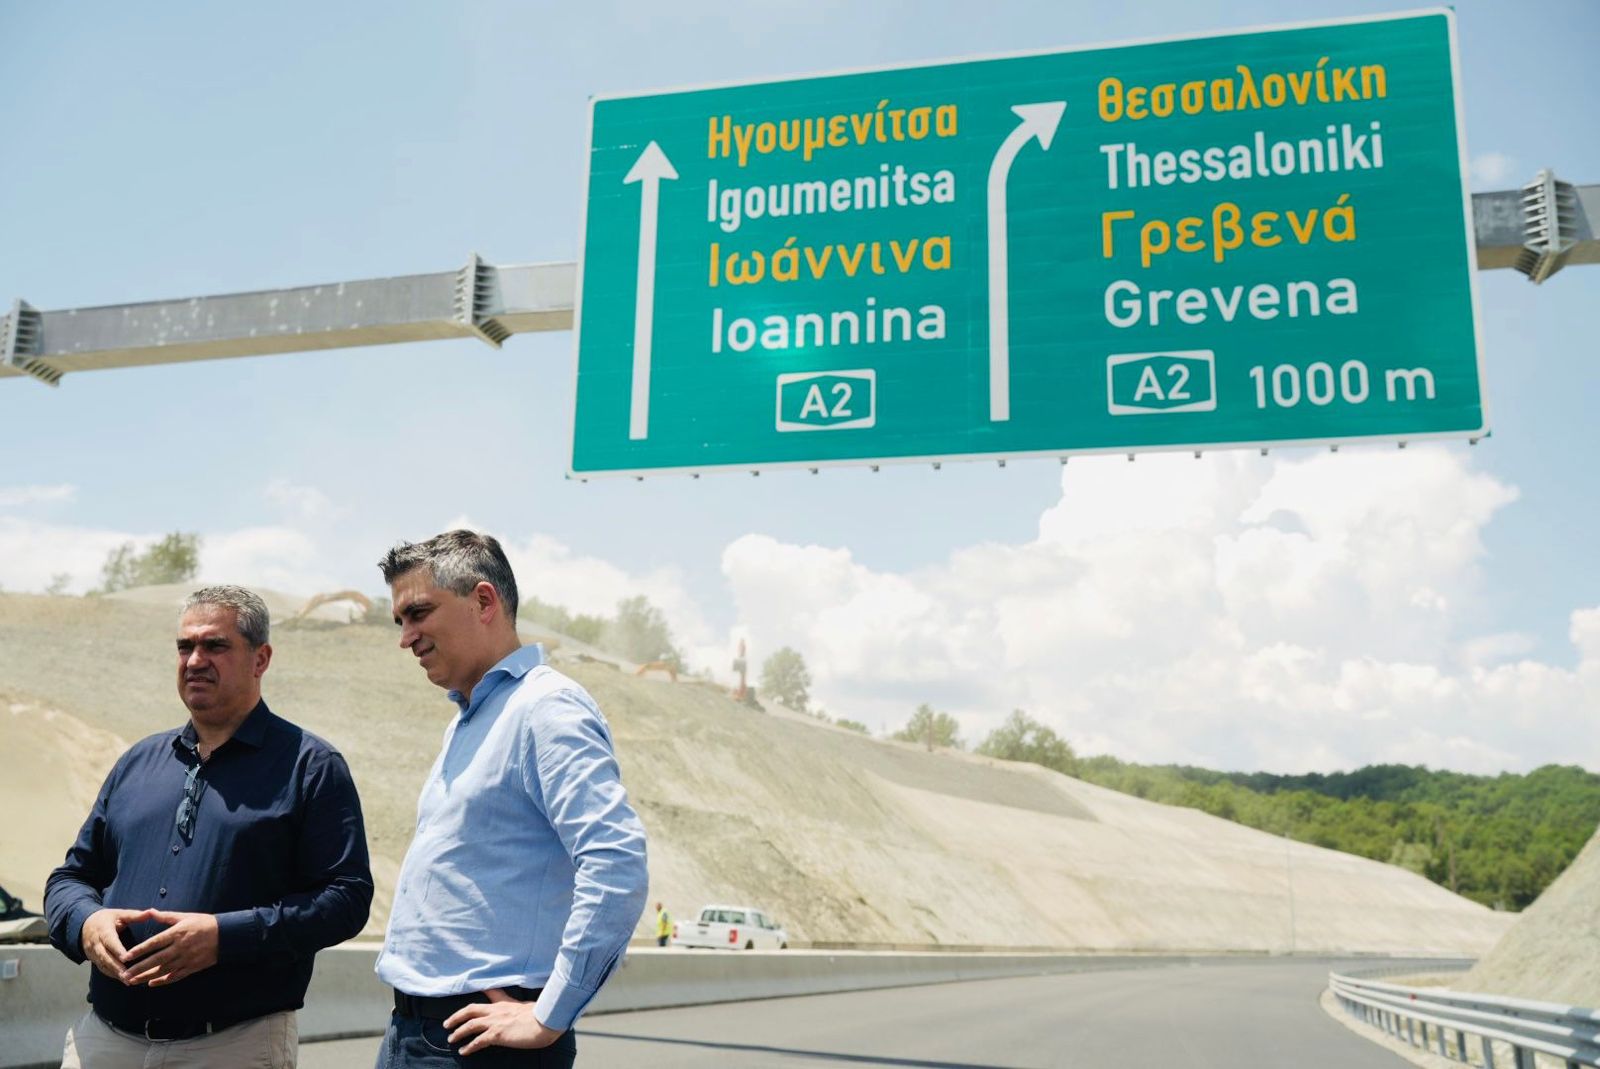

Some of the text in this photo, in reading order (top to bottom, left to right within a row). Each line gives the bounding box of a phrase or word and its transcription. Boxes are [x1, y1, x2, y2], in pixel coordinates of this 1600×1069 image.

[1098, 57, 1387, 123] Θεσσαλονίκη
[709, 99, 957, 167] Ηγουμενίτσα
[1100, 121, 1383, 189] Thessaloniki
[708, 164, 955, 232] Igoumenitsa
[1102, 194, 1356, 268] Γρεβενά
[709, 236, 951, 286] Ιωάννινα
[712, 297, 946, 353] Ioannina
[1105, 278, 1358, 328] Grevena
[800, 382, 852, 419] A2
[1134, 364, 1190, 401] A2
[1250, 360, 1435, 408] 1000 m
